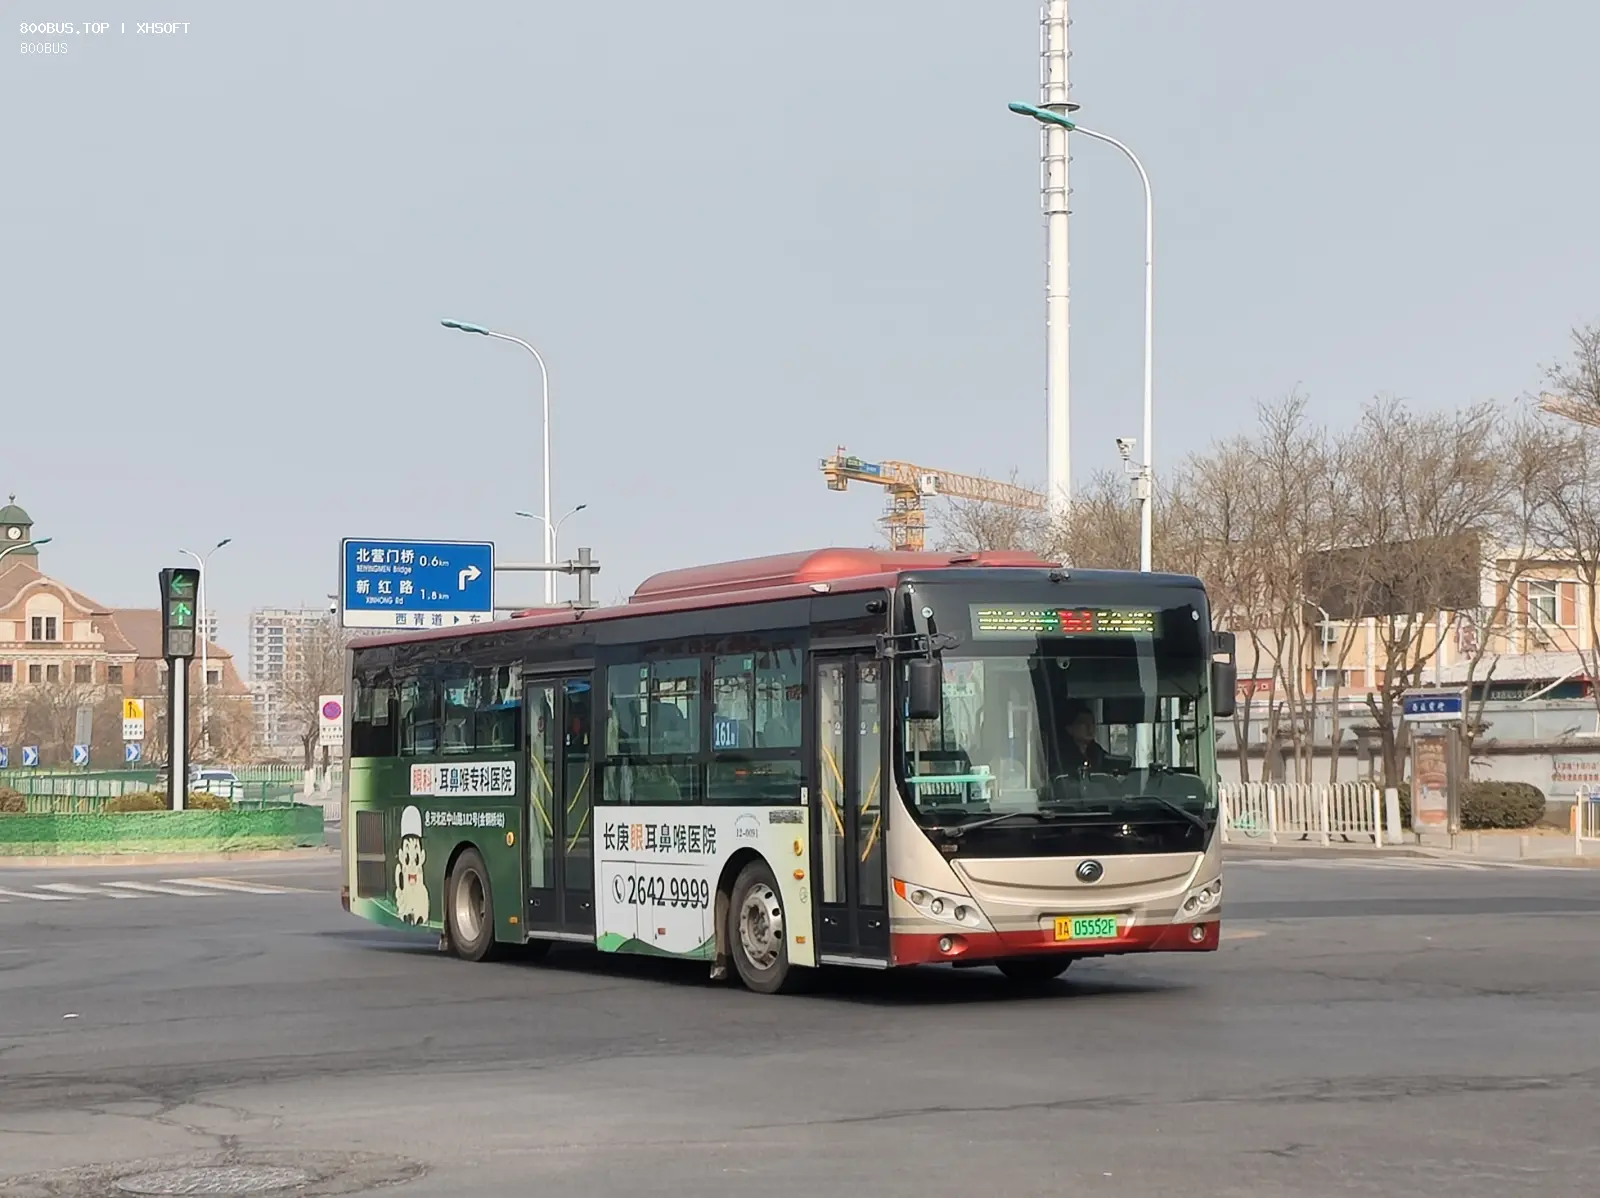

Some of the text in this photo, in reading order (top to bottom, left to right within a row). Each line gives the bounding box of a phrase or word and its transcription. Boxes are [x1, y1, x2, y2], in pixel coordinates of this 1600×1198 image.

[356, 548, 415, 564] 北营门桥
[356, 580, 414, 595] 新红路
[603, 823, 717, 854] 长庚眼耳鼻喉医院
[627, 875, 710, 910] 2642 9999
